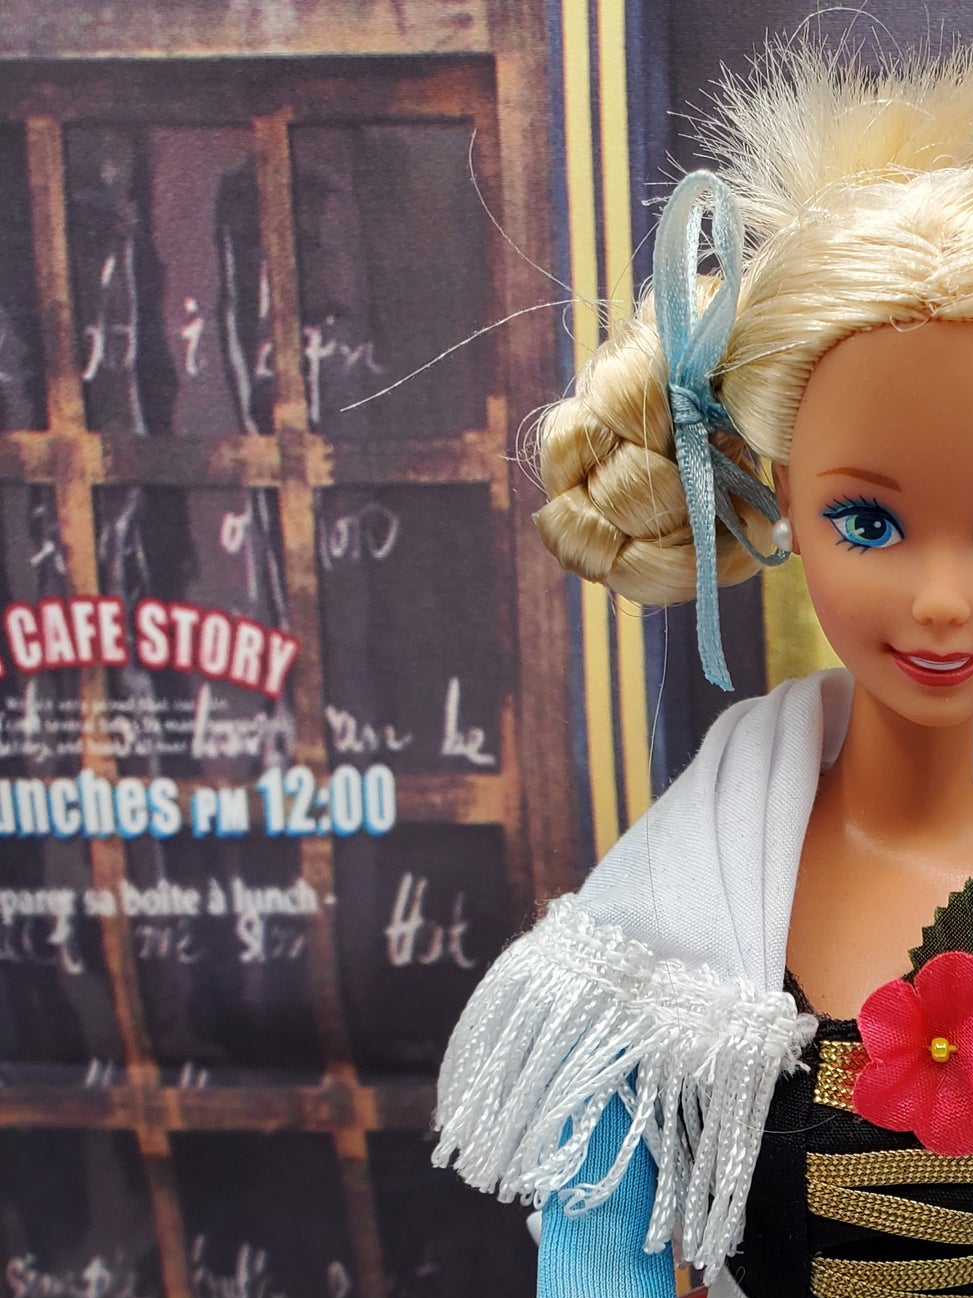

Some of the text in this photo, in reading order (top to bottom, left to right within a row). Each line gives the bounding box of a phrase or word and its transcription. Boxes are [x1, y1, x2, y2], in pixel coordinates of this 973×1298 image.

[6, 599, 298, 698] CAFE STORY
[191, 787, 250, 838] PM
[257, 763, 397, 838] 12:00
